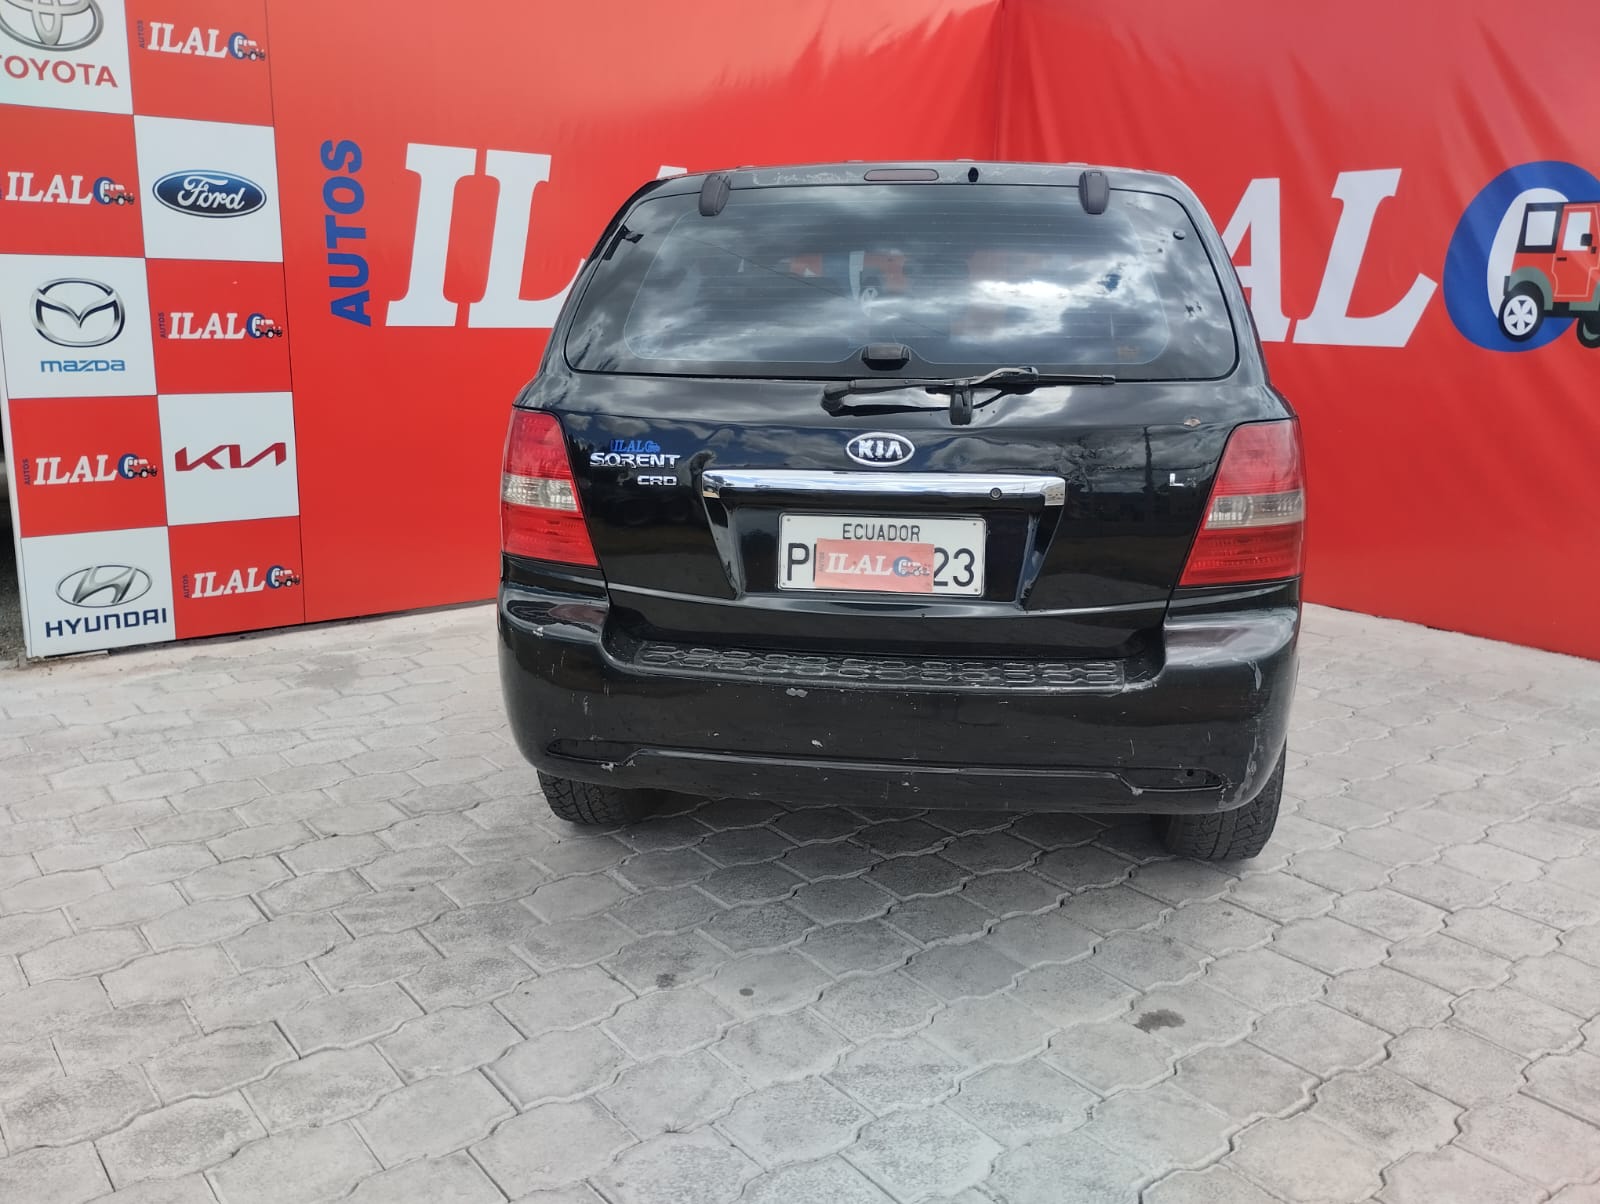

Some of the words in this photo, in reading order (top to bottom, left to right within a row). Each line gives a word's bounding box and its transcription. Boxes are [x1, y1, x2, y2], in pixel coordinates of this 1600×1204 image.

[0, 54, 118, 88] OYOTA
[177, 175, 245, 210] Ford
[320, 139, 371, 327] AUTOS
[40, 359, 126, 373] mazda
[175, 442, 287, 471] KIA
[589, 452, 681, 469] SORENT
[858, 438, 903, 459] KIA
[637, 475, 678, 486] CRD
[842, 523, 921, 541] ECUADOR
[787, 542, 817, 582] P
[45, 608, 167, 638] HYUNDAI
